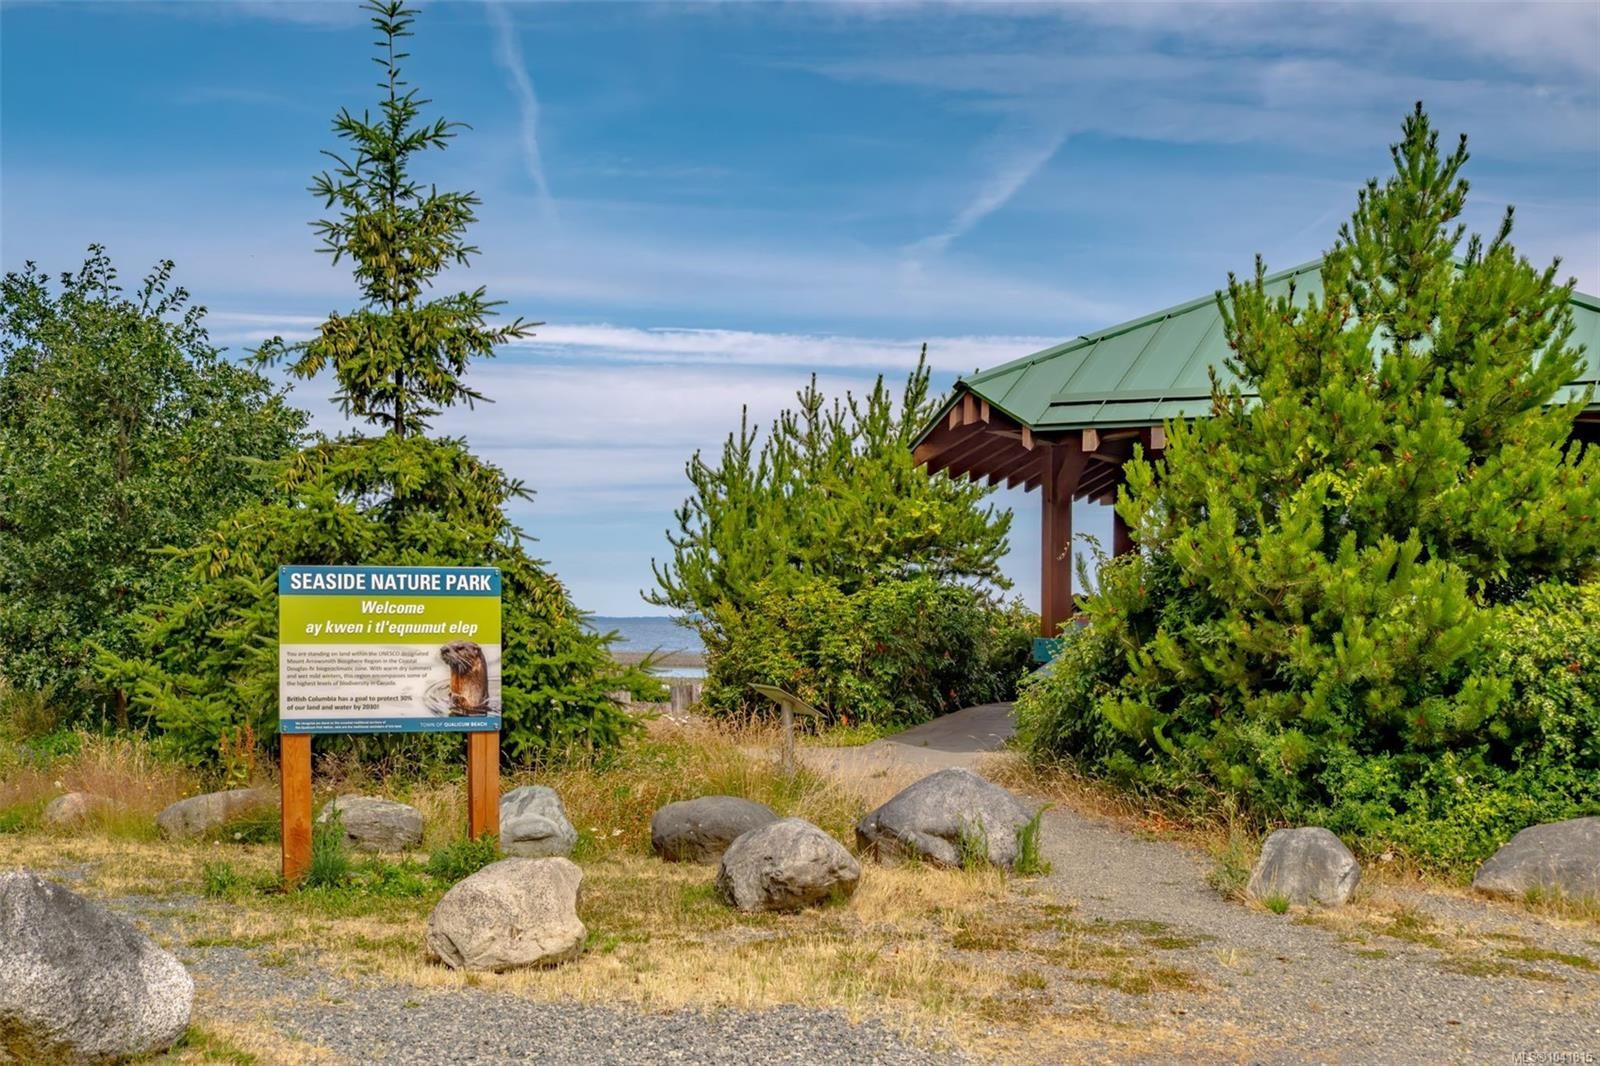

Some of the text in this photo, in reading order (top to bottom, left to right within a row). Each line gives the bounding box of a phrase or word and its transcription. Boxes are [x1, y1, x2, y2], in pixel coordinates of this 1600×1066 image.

[291, 573, 491, 591] SEASIDE NATURE PARK
[361, 601, 424, 614] Welcome
[306, 621, 477, 636] ay kwen i tl'eqnumut elep
